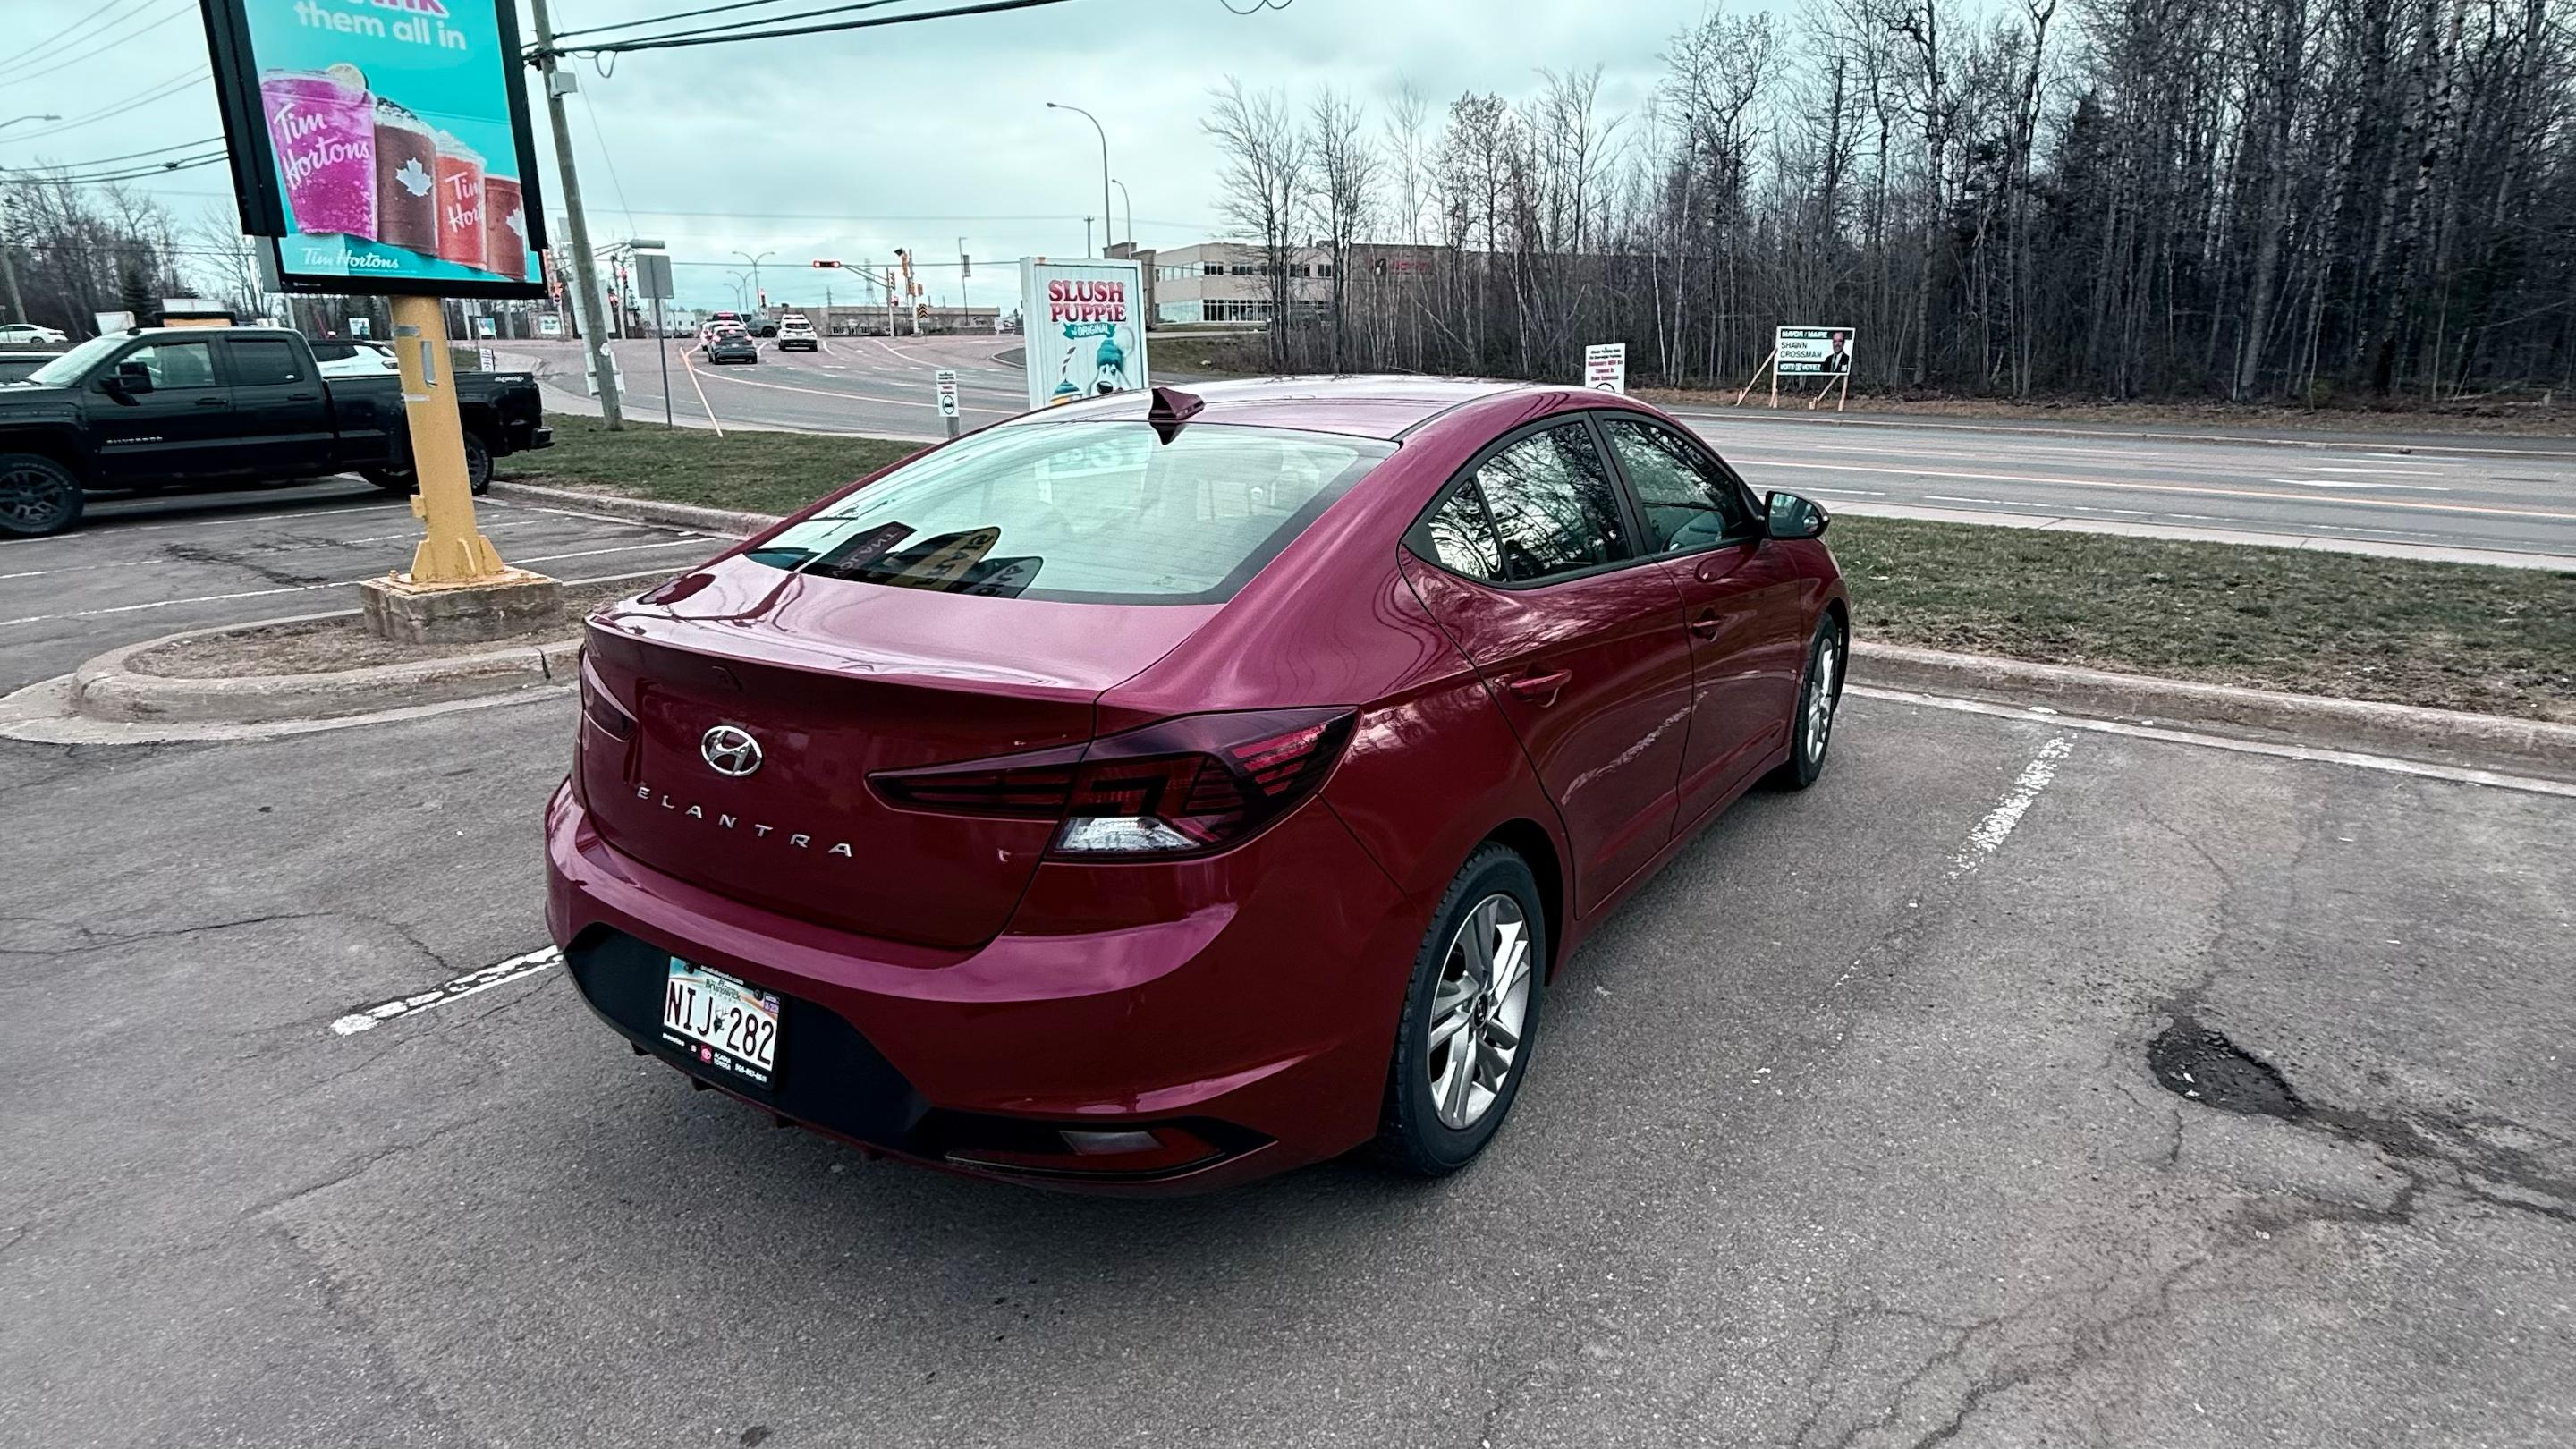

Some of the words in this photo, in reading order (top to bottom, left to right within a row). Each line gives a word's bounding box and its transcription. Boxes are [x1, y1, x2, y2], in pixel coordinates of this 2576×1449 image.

[293, 1, 386, 38] them
[393, 17, 431, 45] all
[436, 20, 467, 51] in
[274, 103, 327, 145] Tim
[282, 135, 370, 191] Hortons
[301, 247, 334, 266] Tim
[335, 250, 400, 269] Hortons
[1048, 280, 1125, 303] SLUSH
[1077, 323, 1111, 336] ORIGINAL
[1782, 330, 1804, 338] MAYOR
[1780, 350, 1822, 359] CROSSMAN
[1781, 341, 1808, 350] SHAWN
[1780, 363, 1795, 371] VOTE
[636, 785, 852, 858] ELANTRA
[666, 980, 714, 1038] NIJ
[726, 1006, 775, 1066] 282
